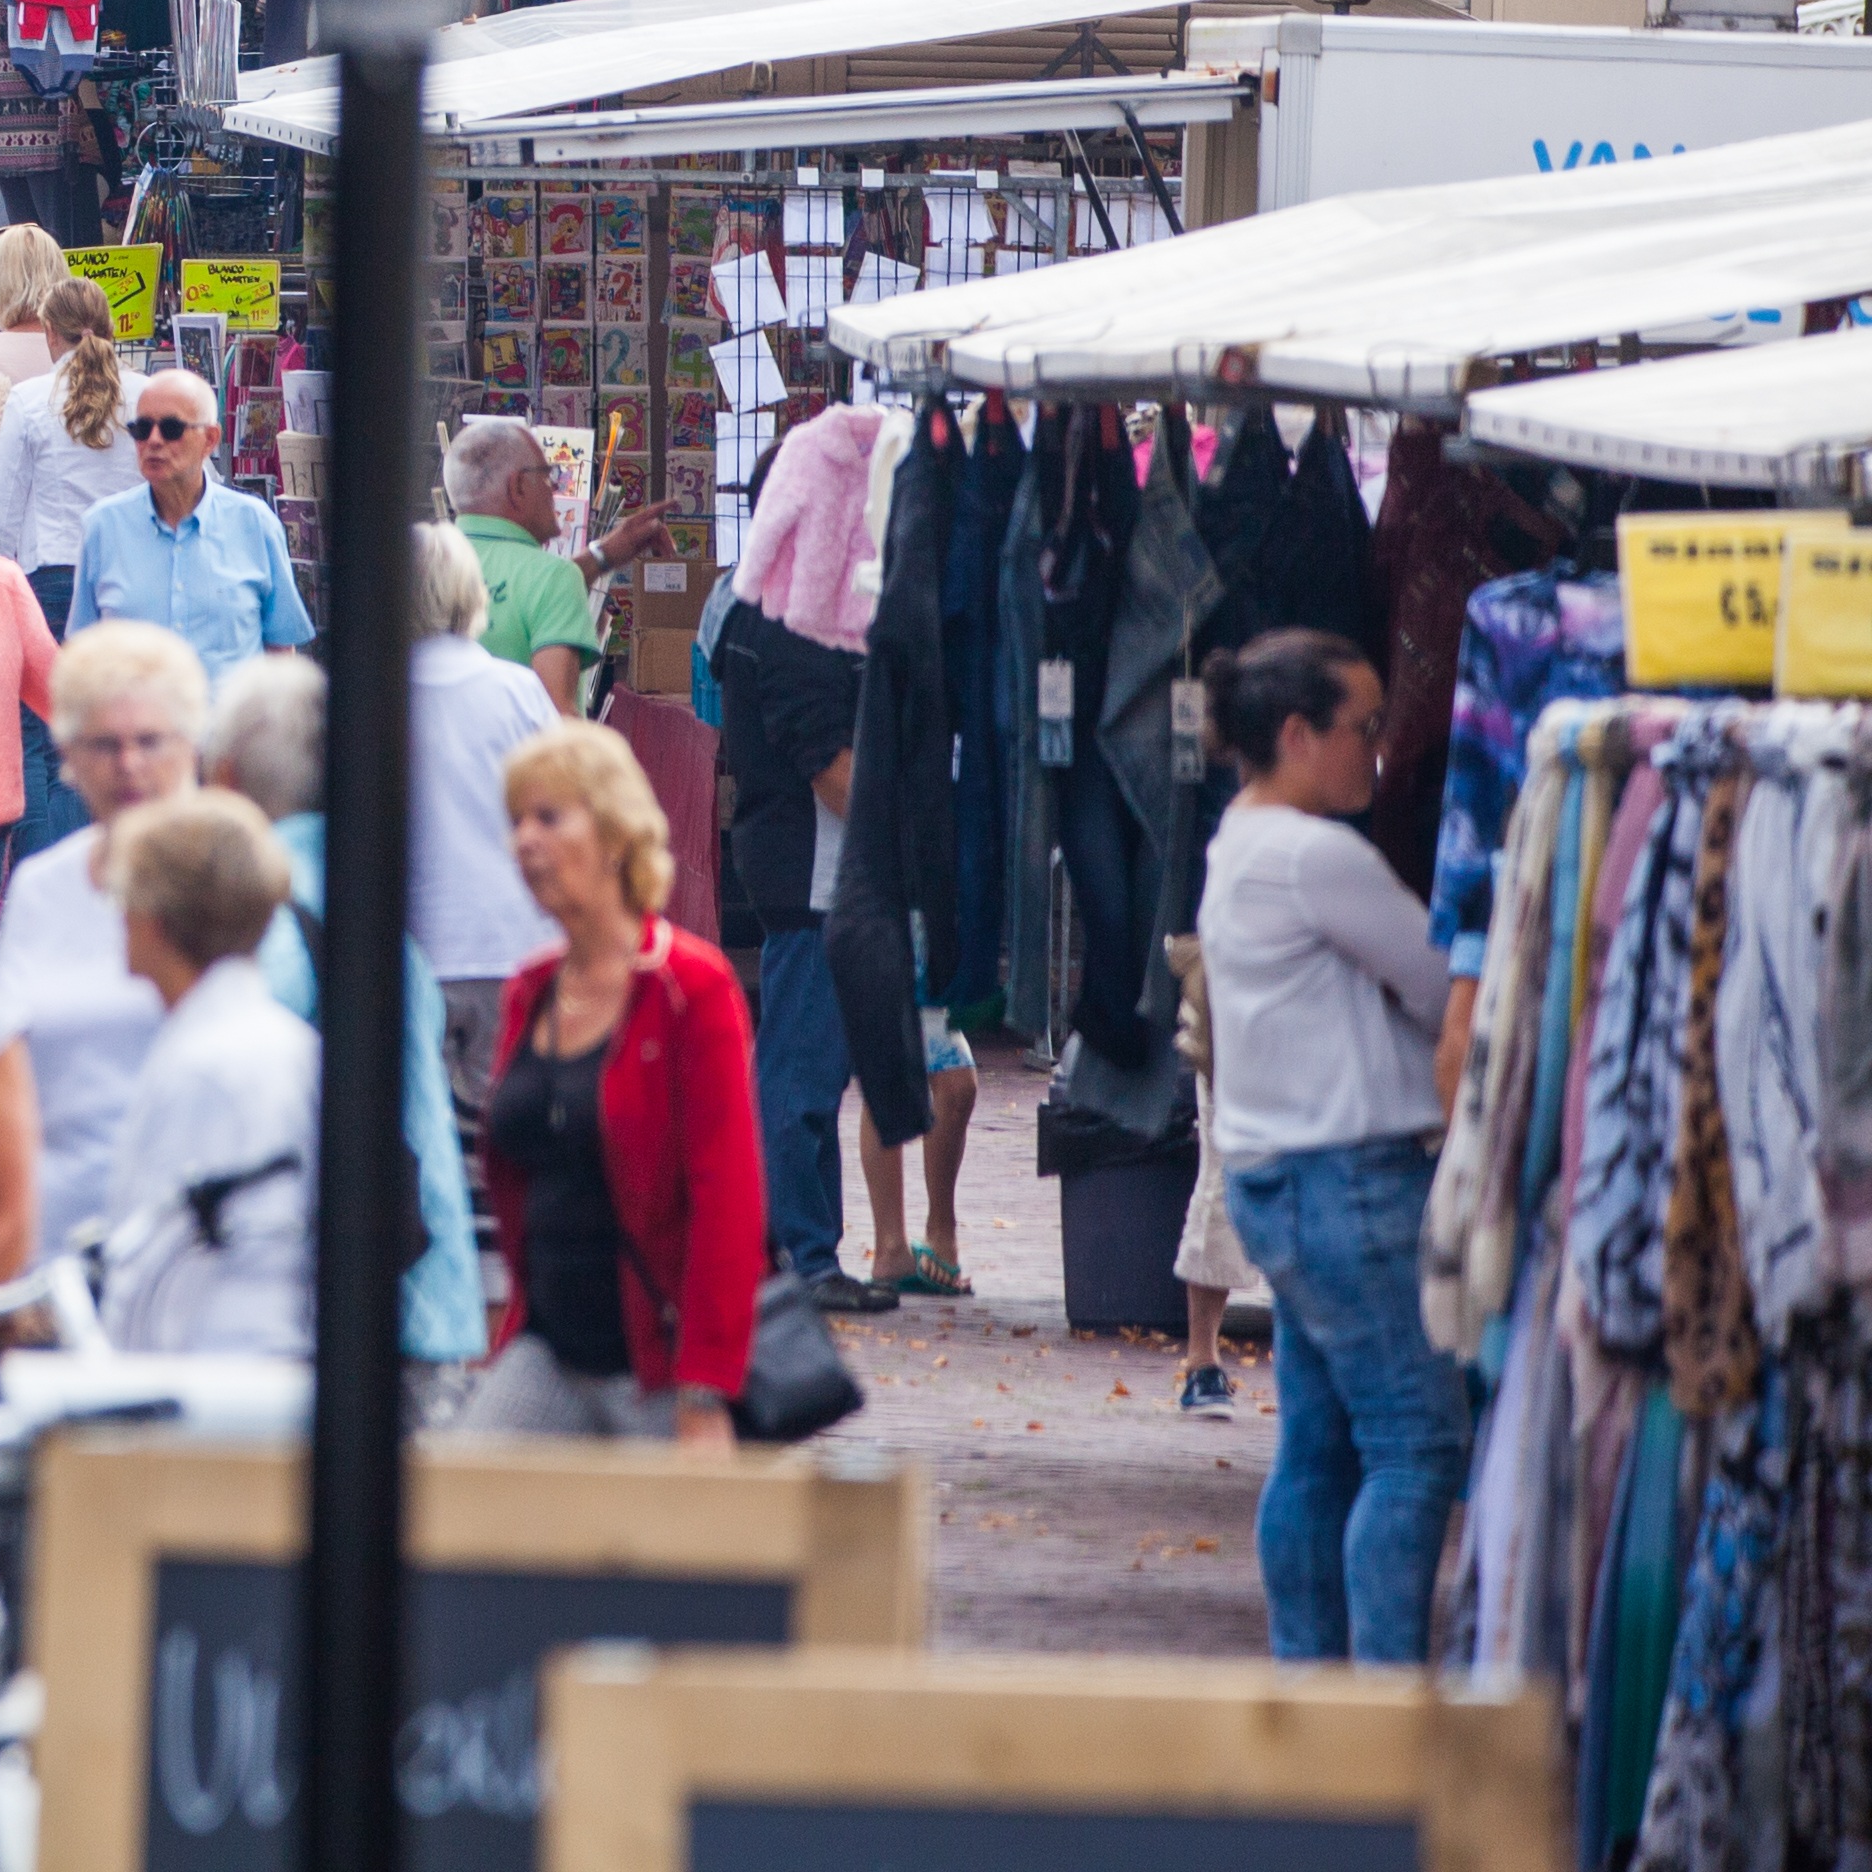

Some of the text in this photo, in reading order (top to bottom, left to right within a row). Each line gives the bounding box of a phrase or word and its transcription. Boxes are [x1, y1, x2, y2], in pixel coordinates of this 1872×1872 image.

[67, 252, 110, 267] BLANCO
[207, 263, 245, 275] BLANCO
[611, 271, 634, 307] 2
